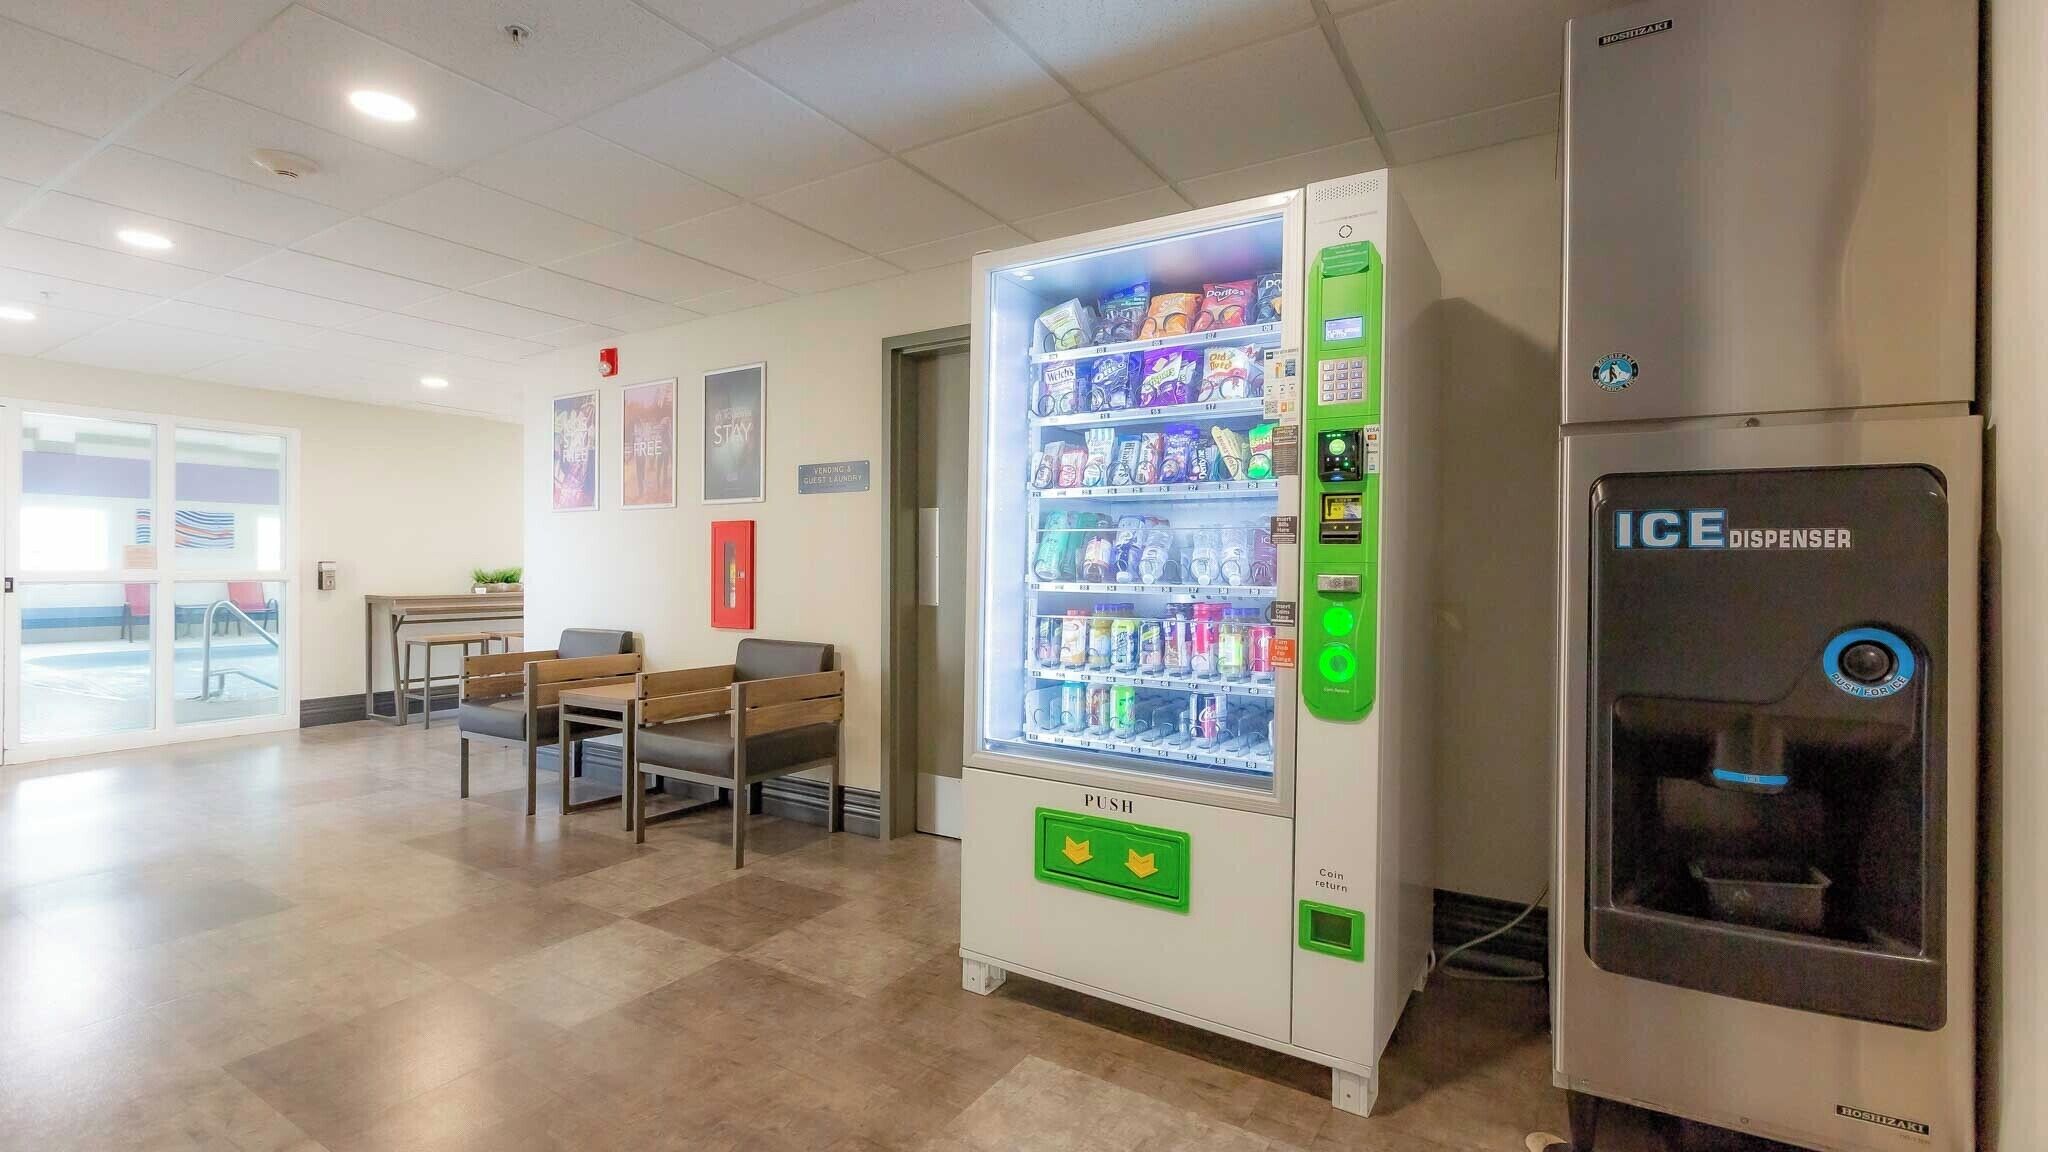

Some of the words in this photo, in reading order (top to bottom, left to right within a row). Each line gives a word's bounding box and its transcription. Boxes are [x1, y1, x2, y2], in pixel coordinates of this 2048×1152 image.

[1603, 21, 1669, 44] HOSHIZAKI
[1206, 288, 1246, 300] Doritos
[713, 421, 753, 445] STAY
[633, 440, 663, 457] FREE
[815, 465, 844, 474] VENDING
[804, 476, 826, 485] GUEST
[829, 474, 862, 483] LAUNDRY
[1616, 508, 1728, 549] ICE
[1729, 528, 1851, 549] DISPENSER
[1831, 672, 1860, 694] PUSH
[1863, 687, 1888, 697] FOR
[1890, 676, 1906, 692] ICE
[1085, 794, 1133, 813] PUSH
[1319, 868, 1344, 880] Coin
[1315, 880, 1348, 892] return
[1841, 1106, 1925, 1133] HOSHIZAKI
